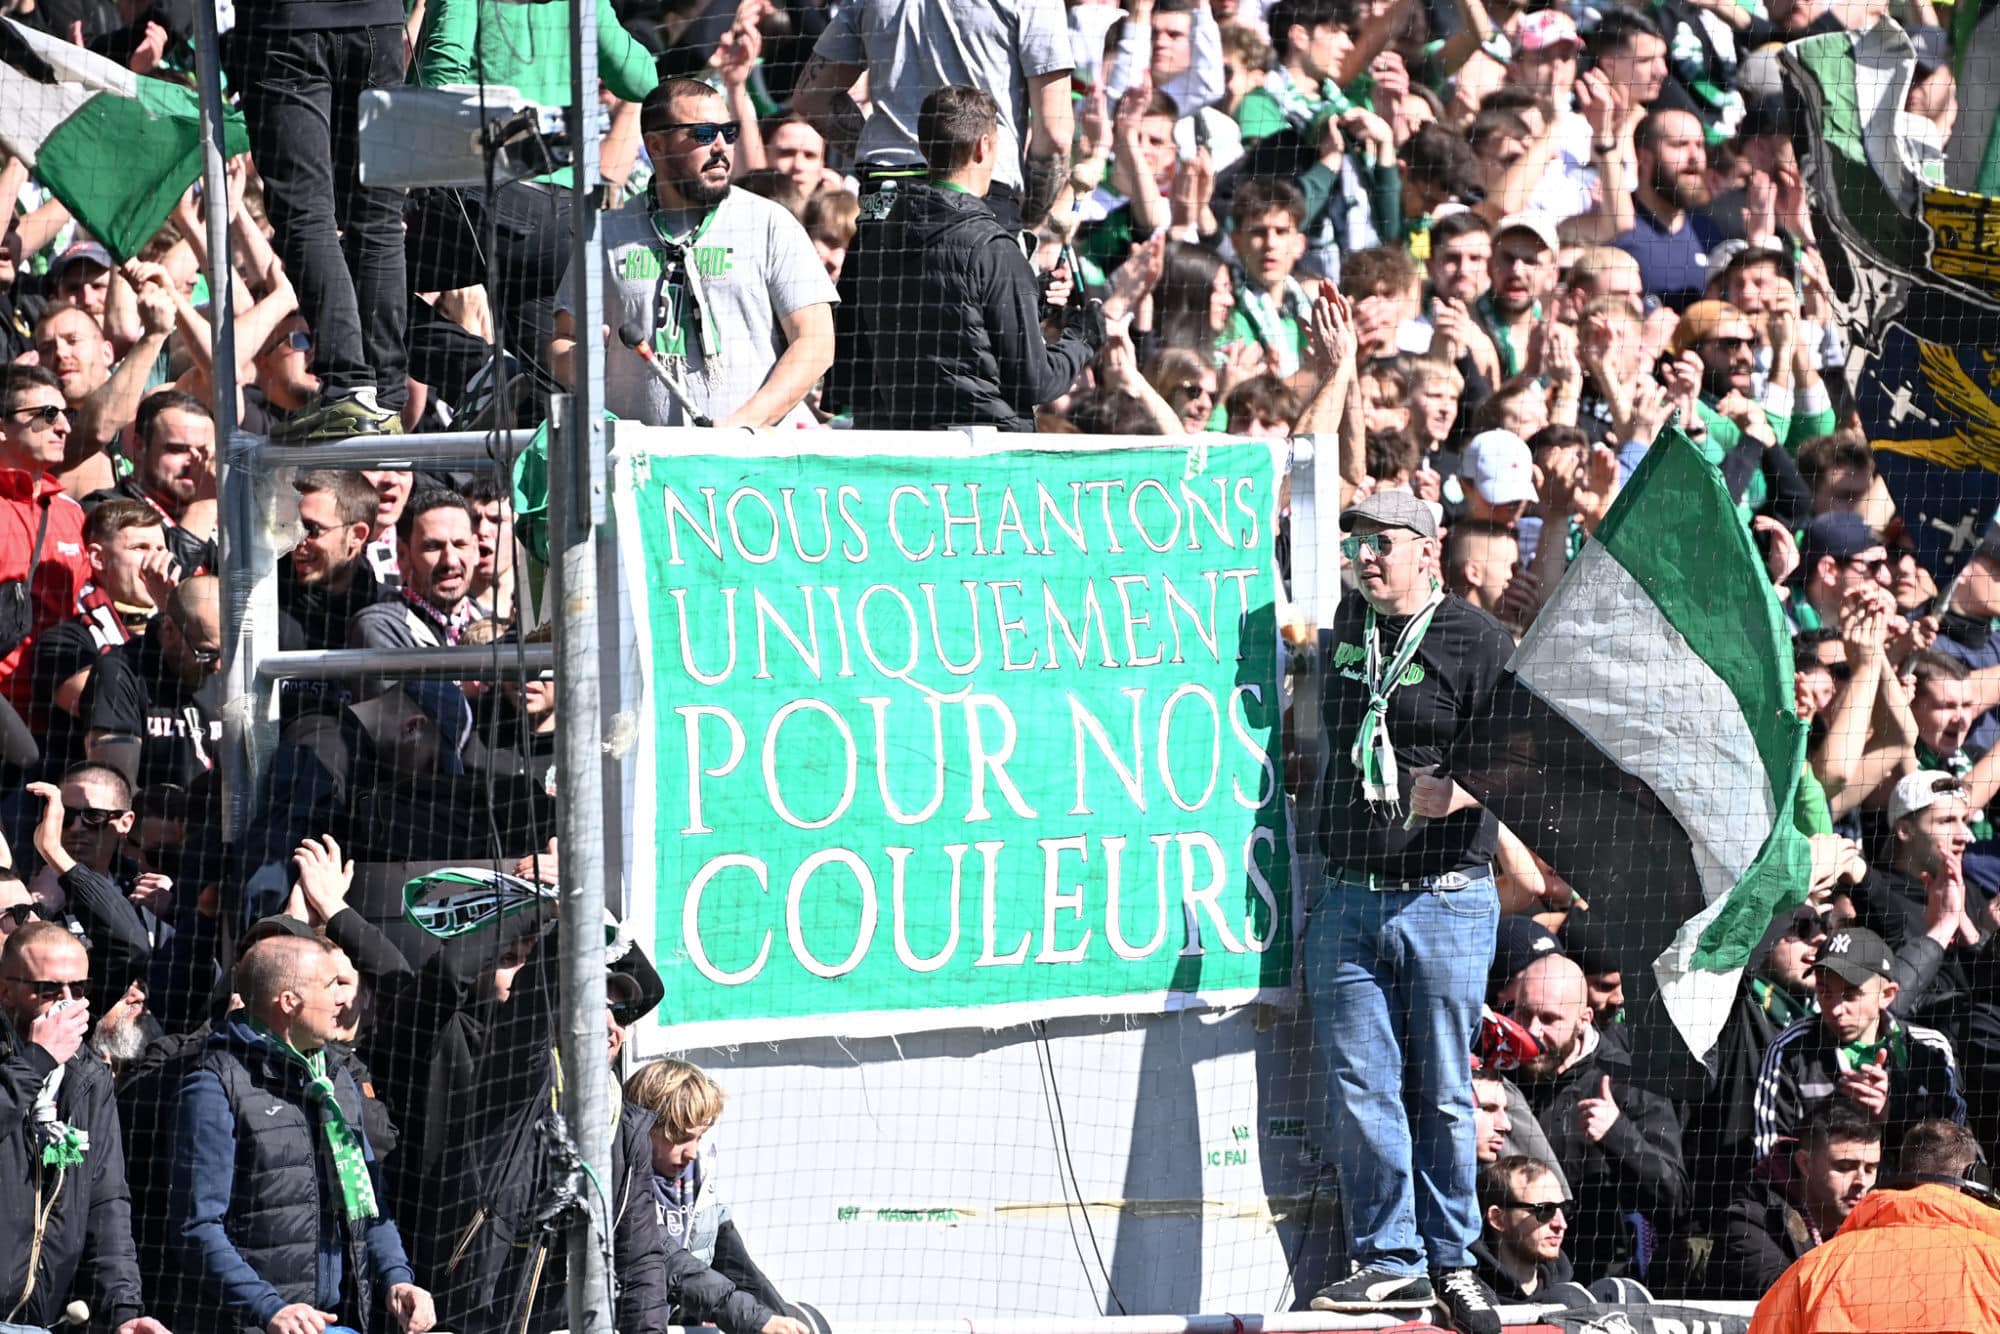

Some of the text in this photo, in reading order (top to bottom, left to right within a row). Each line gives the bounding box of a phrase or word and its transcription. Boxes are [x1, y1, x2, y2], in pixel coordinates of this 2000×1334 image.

[663, 477, 1259, 565] NOUS CHANTONS
[668, 567, 1259, 703] UNIQUEMENT
[675, 683, 1274, 834] POUR NOS
[682, 826, 1278, 985] COULEURS
